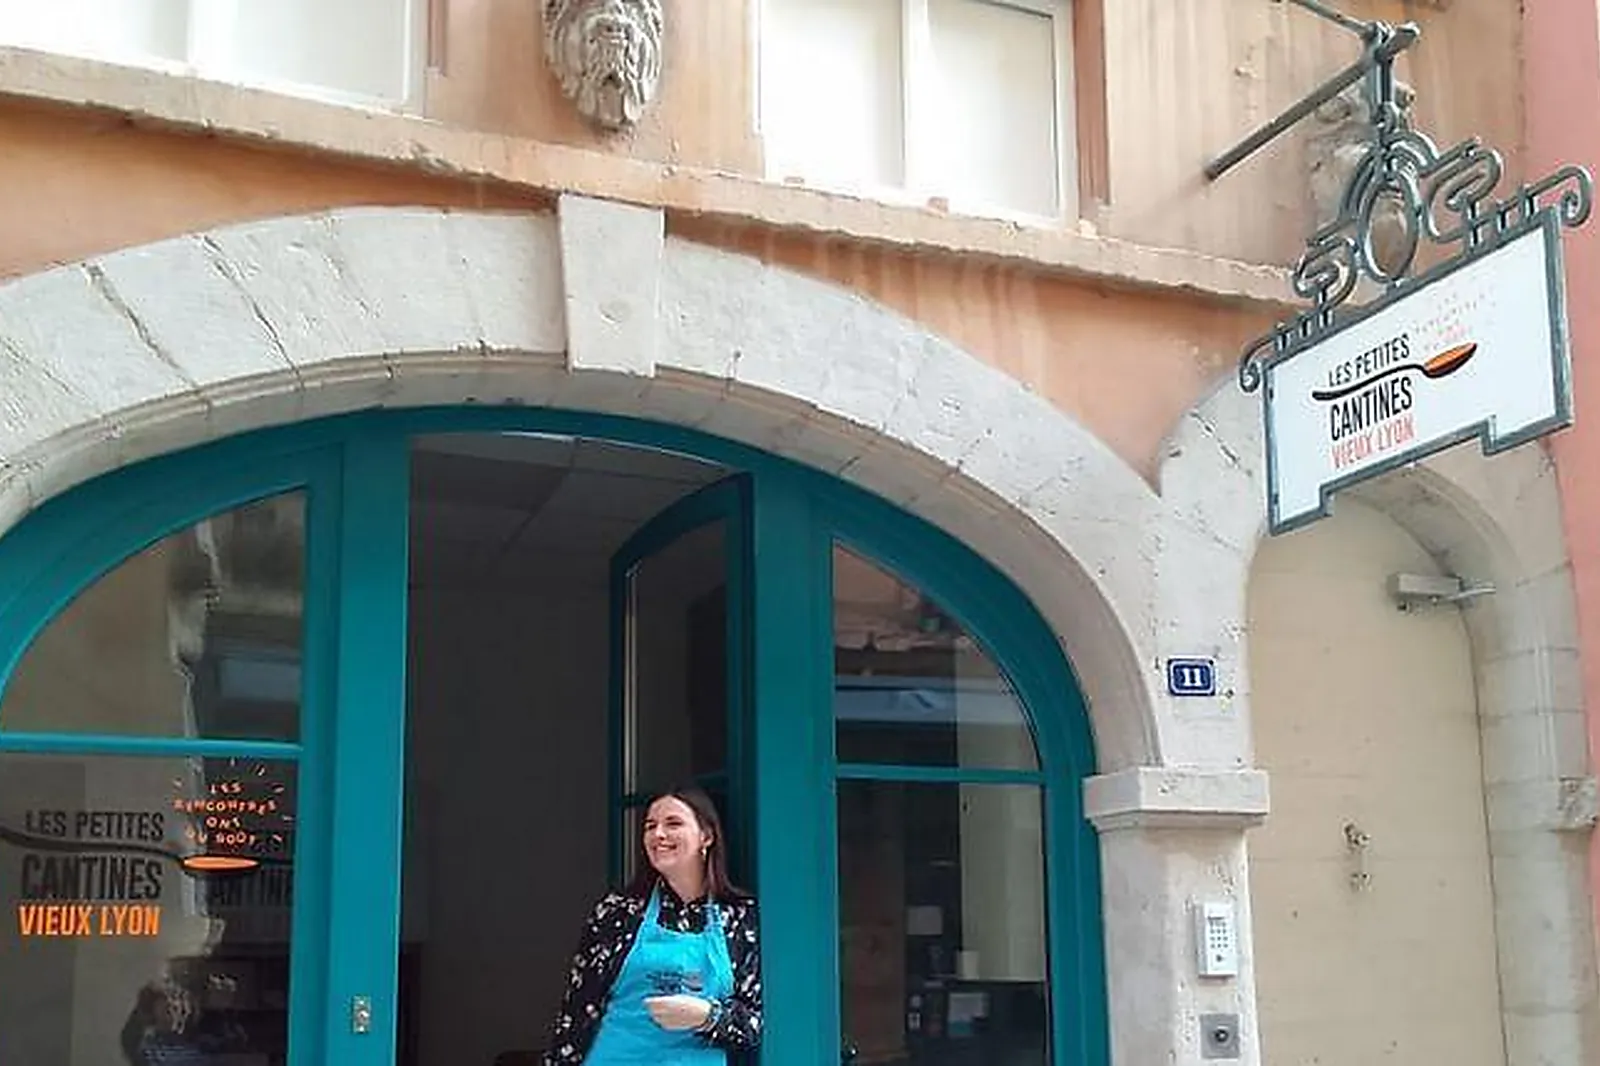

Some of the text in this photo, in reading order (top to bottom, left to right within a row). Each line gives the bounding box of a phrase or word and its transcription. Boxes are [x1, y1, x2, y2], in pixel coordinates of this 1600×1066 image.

[1328, 333, 1410, 388] LES PETITES
[1330, 376, 1413, 441] CANTINES
[1331, 414, 1416, 470] VIEUX LYON
[1182, 668, 1203, 687] 11
[25, 810, 165, 842] LES PETITES
[22, 854, 163, 901] CANTINES
[19, 904, 160, 936] VIEUX LYON
